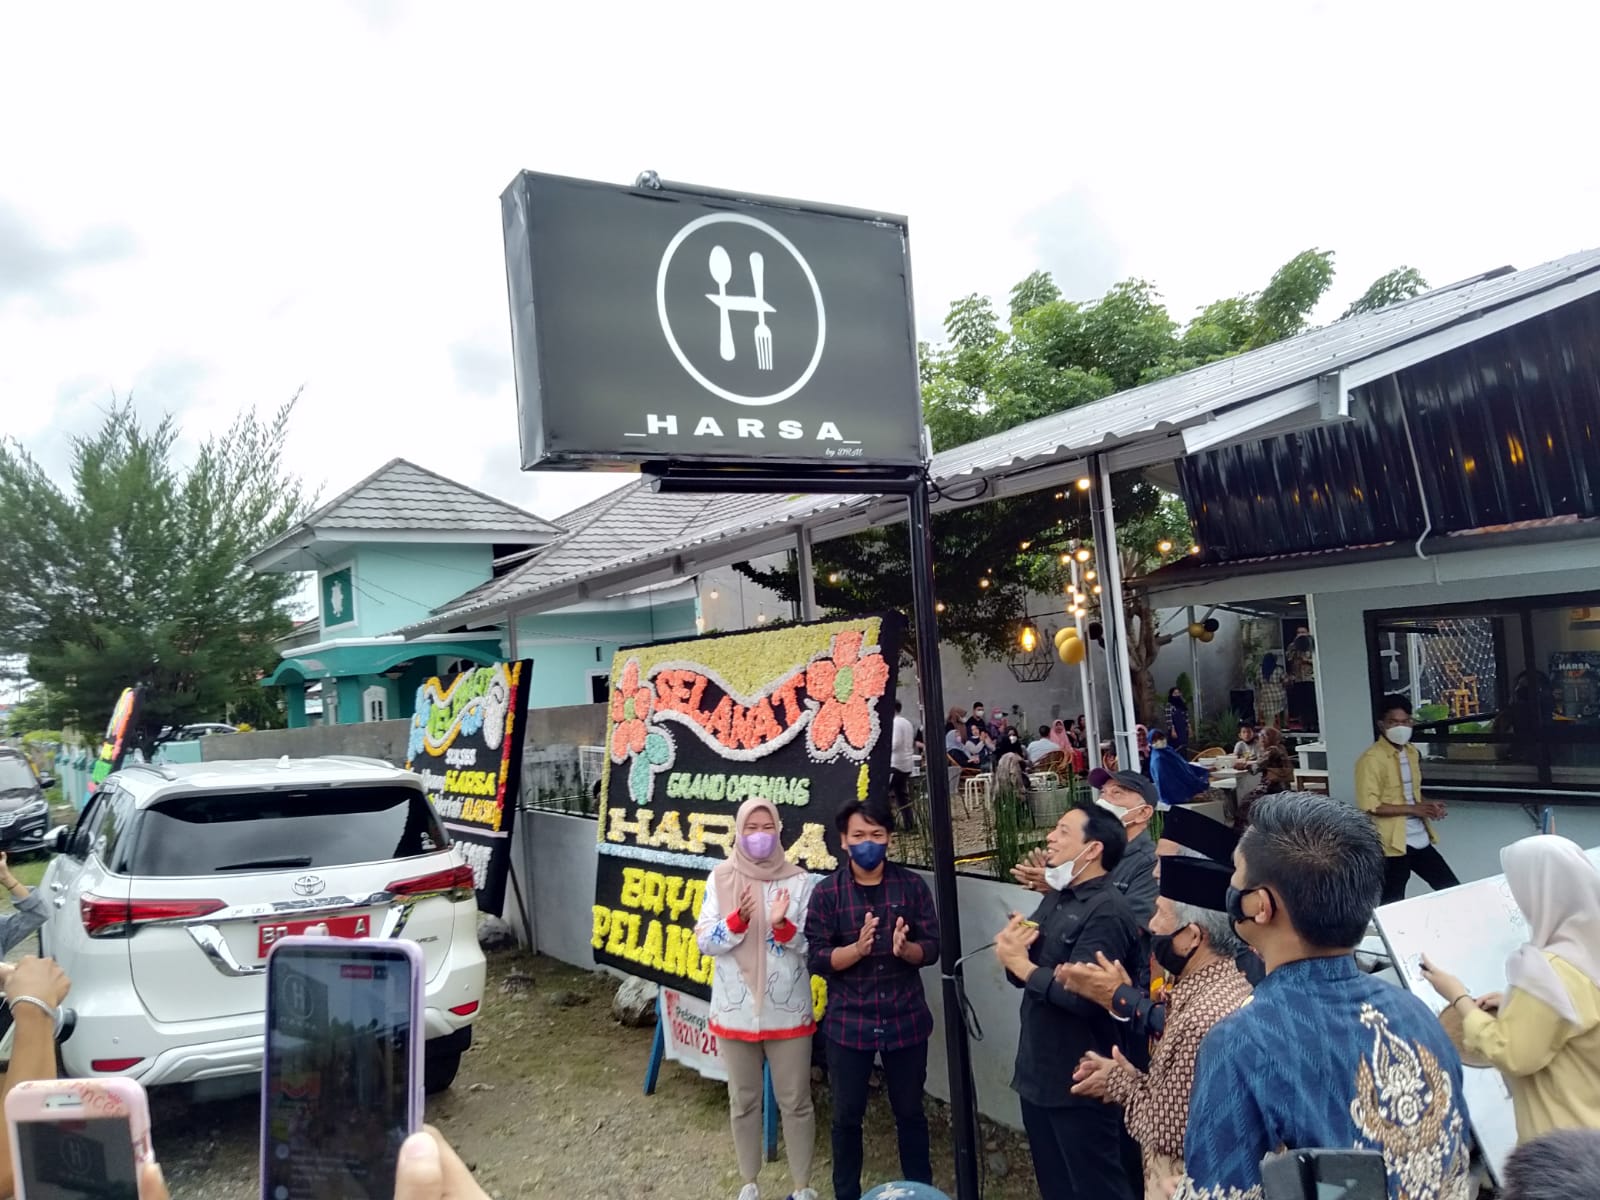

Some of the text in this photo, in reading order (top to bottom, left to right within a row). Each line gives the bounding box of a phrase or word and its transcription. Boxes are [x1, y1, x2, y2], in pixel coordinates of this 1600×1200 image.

[647, 413, 844, 442] HARSA
[825, 447, 836, 457] by
[653, 669, 806, 750] SELAMAT
[444, 769, 497, 797] HARSA
[666, 772, 810, 806] GRAND OPENING
[606, 807, 838, 871] HARA
[354, 918, 367, 935] A
